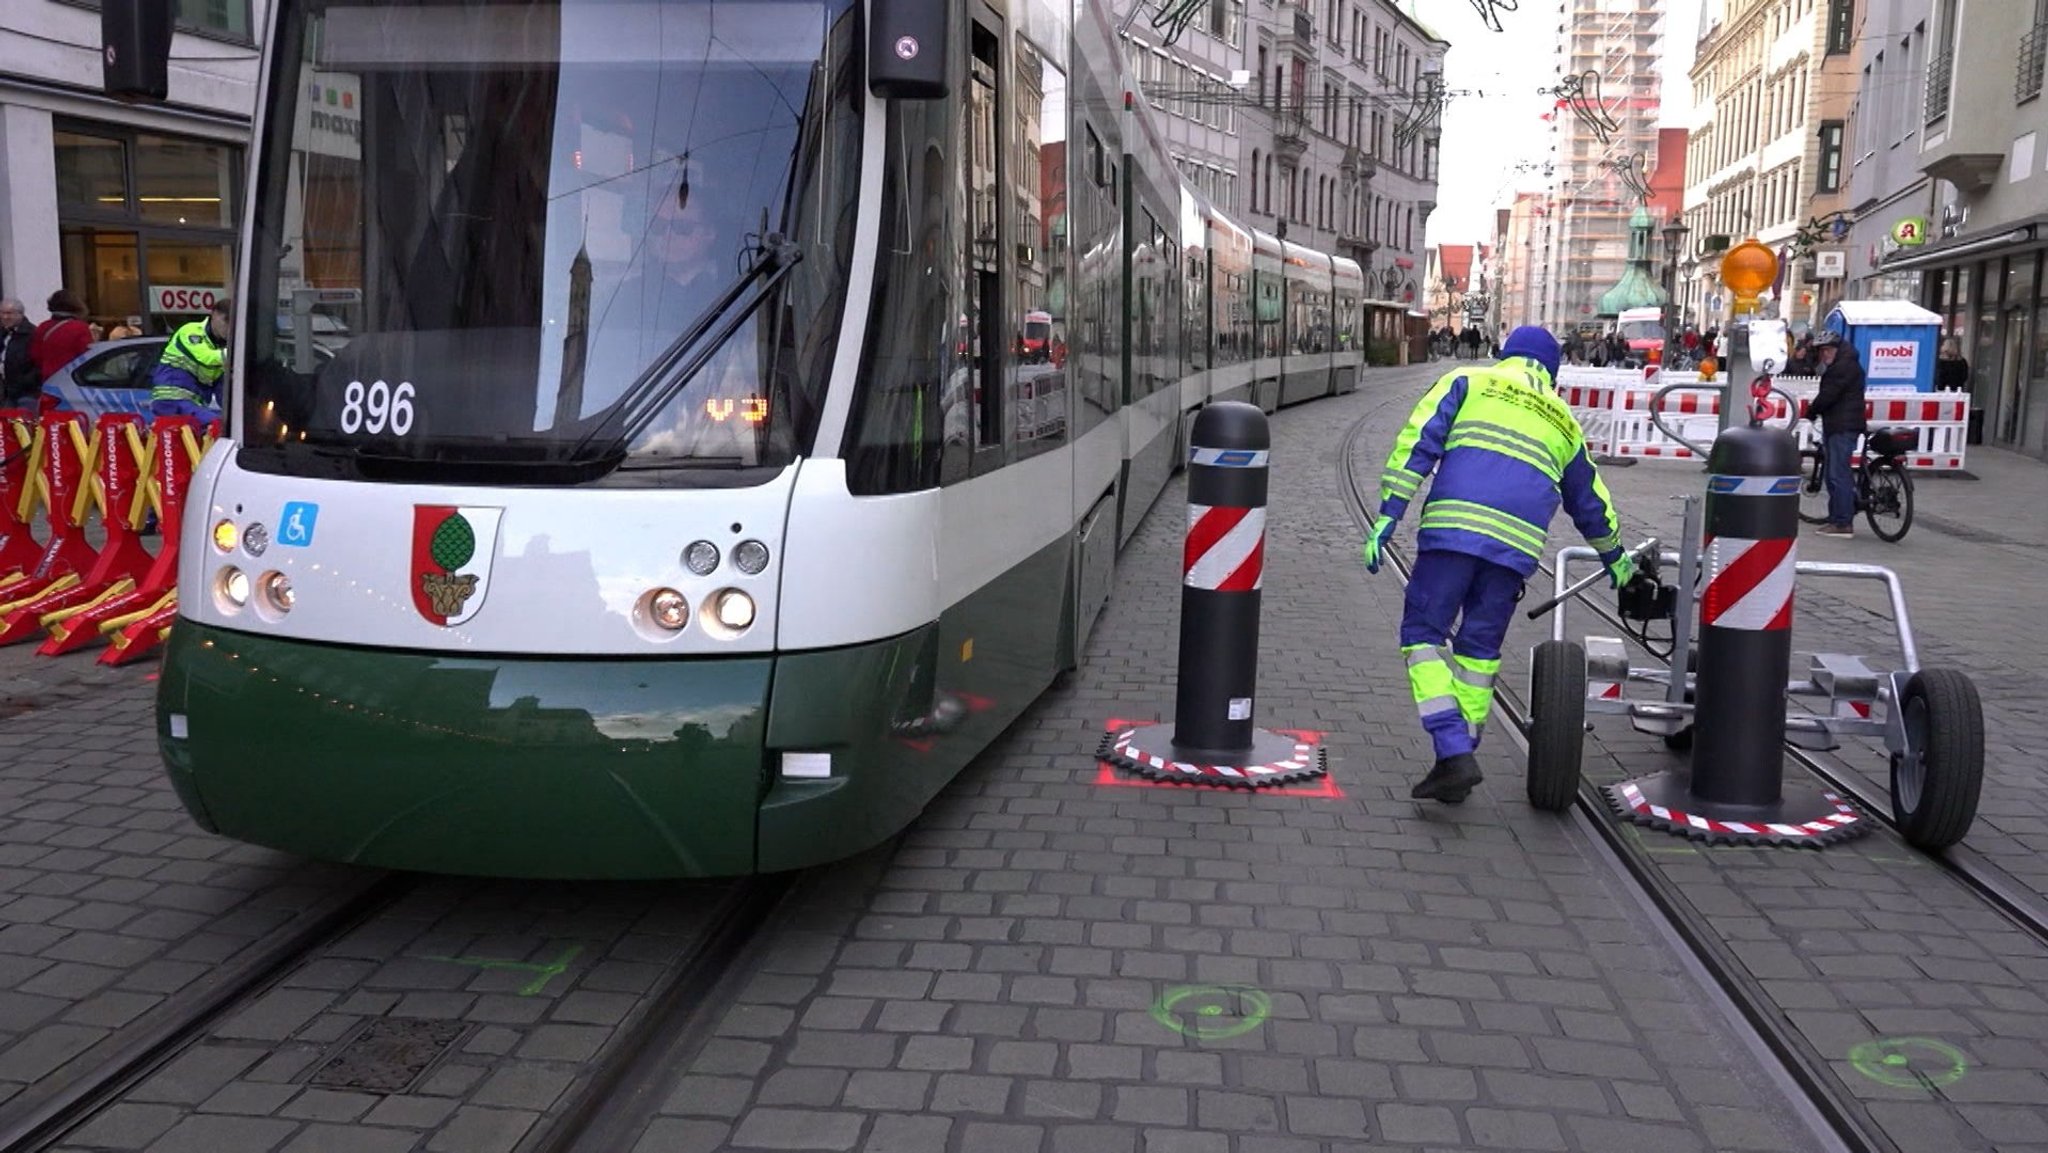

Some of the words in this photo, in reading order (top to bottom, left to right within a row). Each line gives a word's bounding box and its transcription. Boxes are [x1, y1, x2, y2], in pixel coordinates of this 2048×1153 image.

[161, 290, 216, 311] OSCO
[1875, 345, 1913, 357] mobi
[341, 379, 416, 437] 896
[106, 426, 119, 490] PITAGONE
[162, 431, 175, 496] PITAGONE
